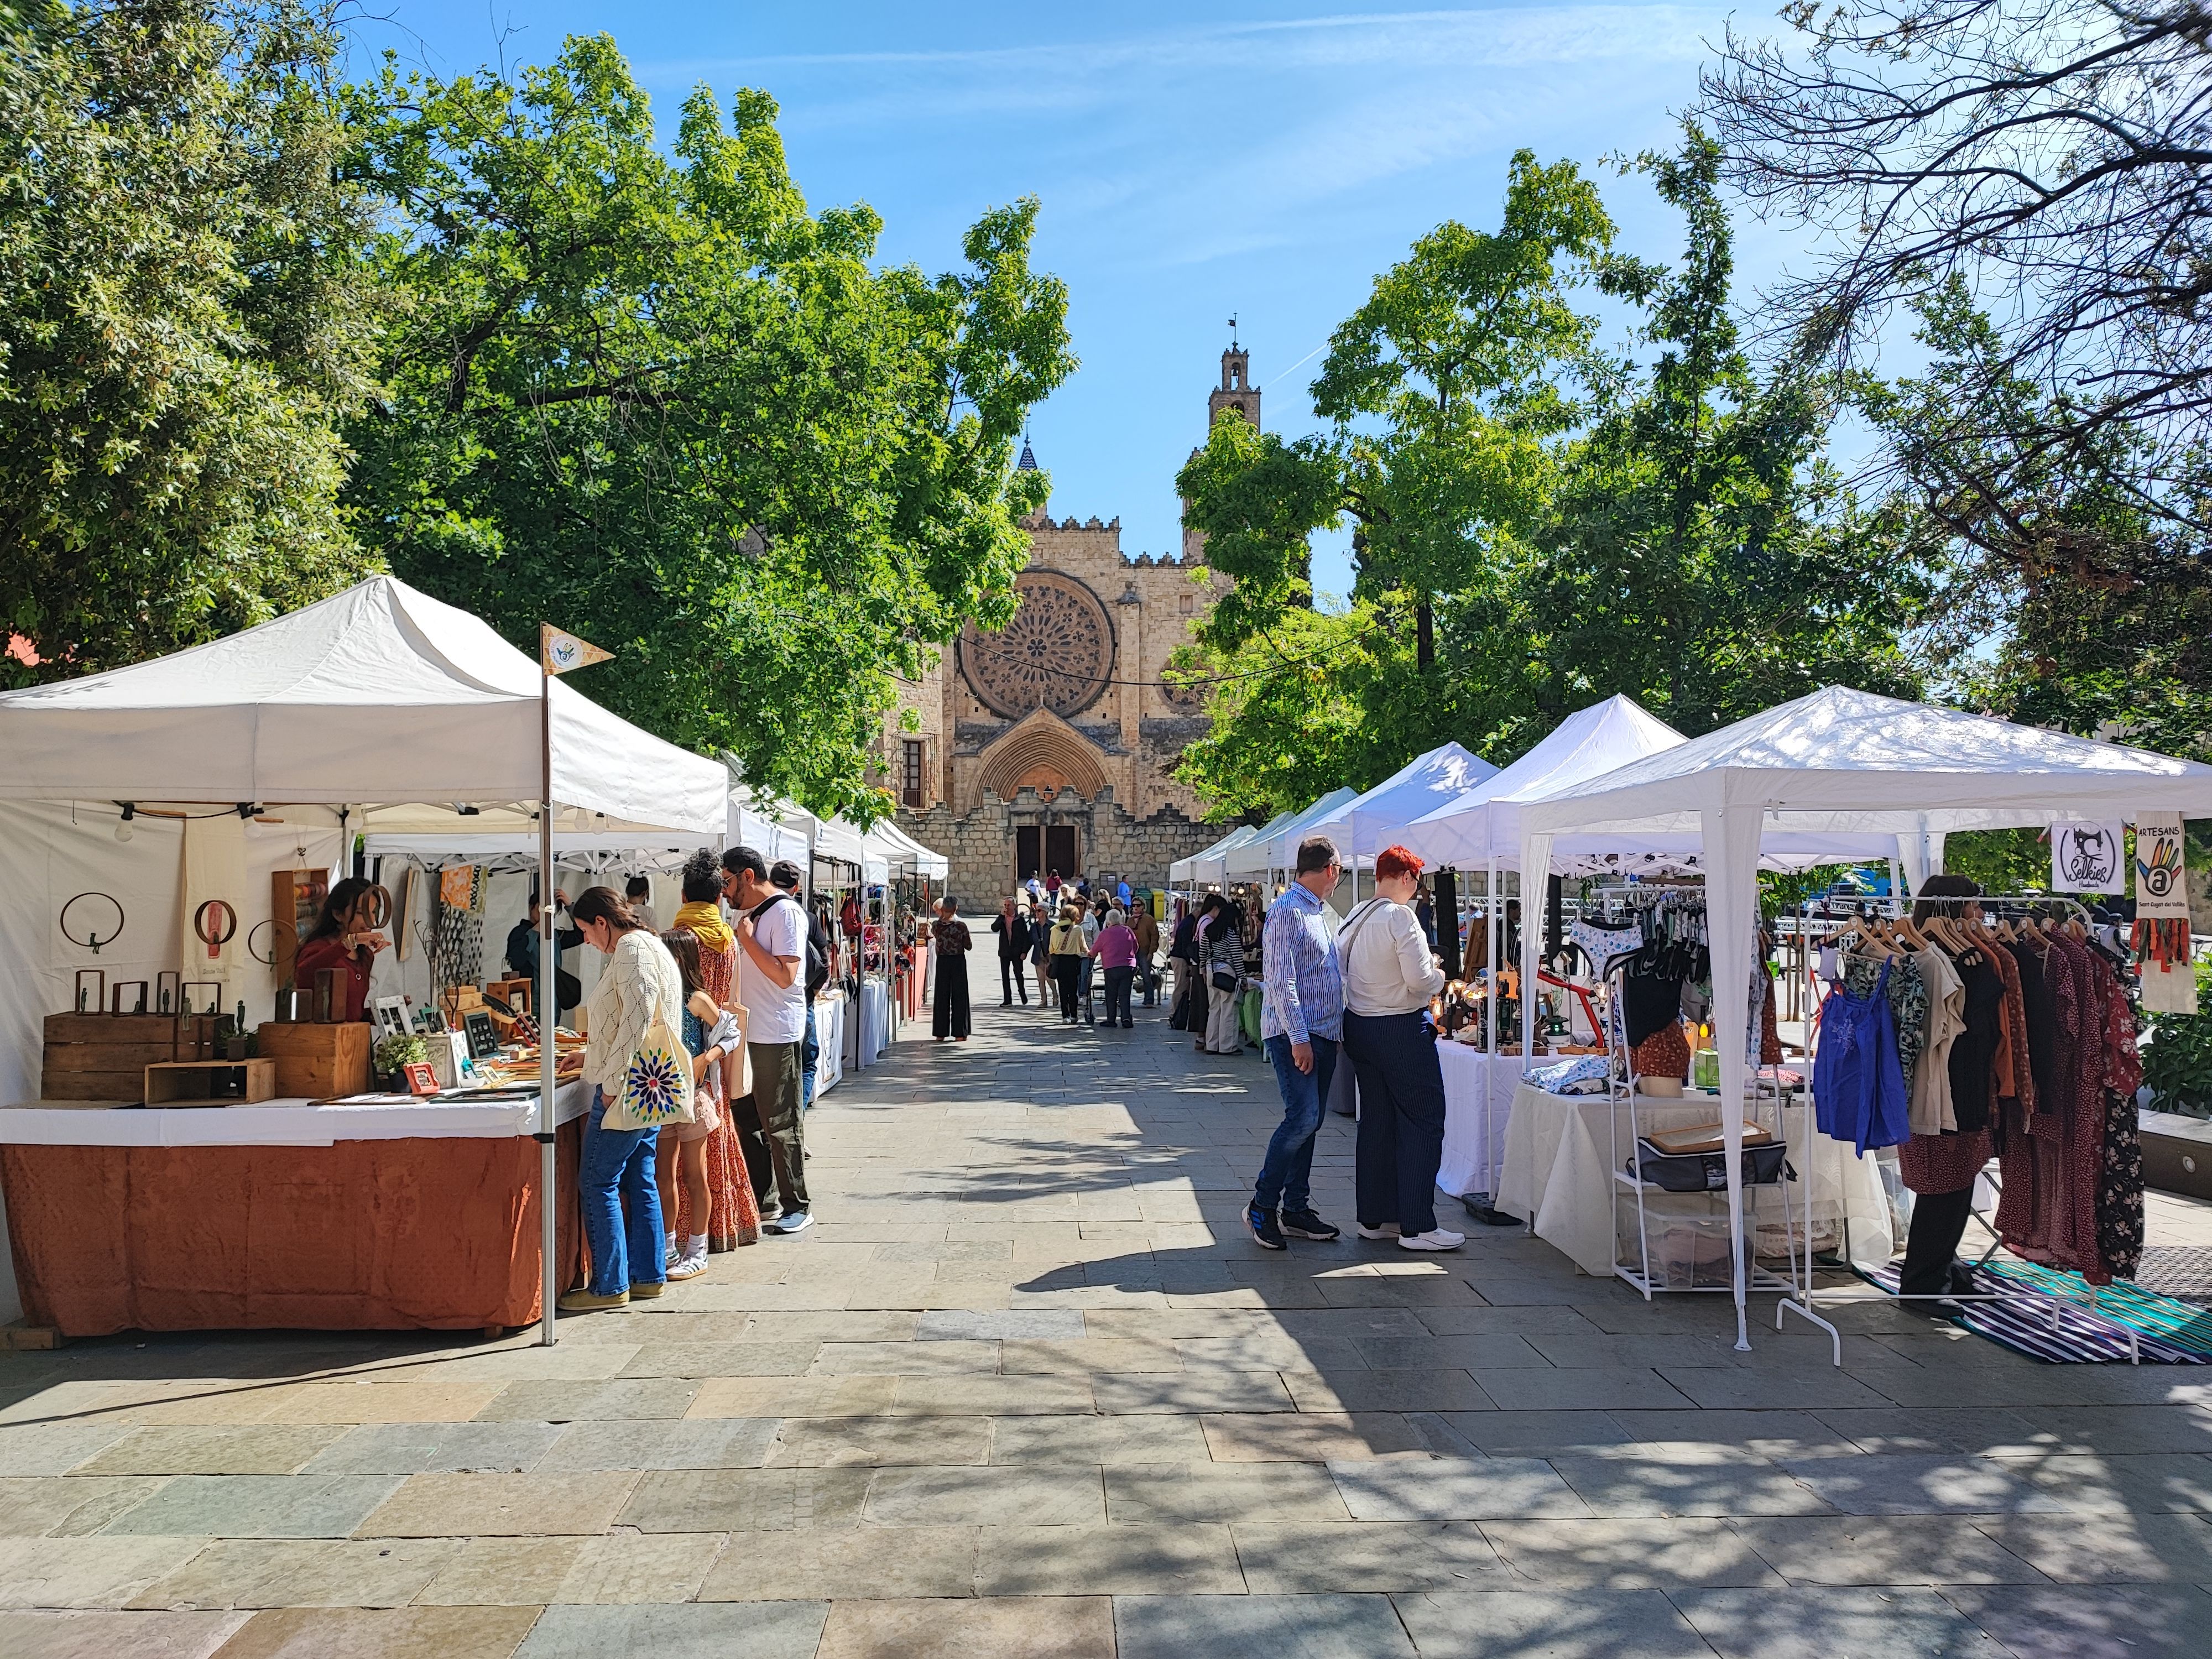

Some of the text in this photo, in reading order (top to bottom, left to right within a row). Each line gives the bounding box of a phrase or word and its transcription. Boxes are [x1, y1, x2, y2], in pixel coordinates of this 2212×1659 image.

[2138, 826, 2179, 837] ARTESANS
[2069, 858, 2107, 883] Selkies
[2152, 870, 2167, 891] a
